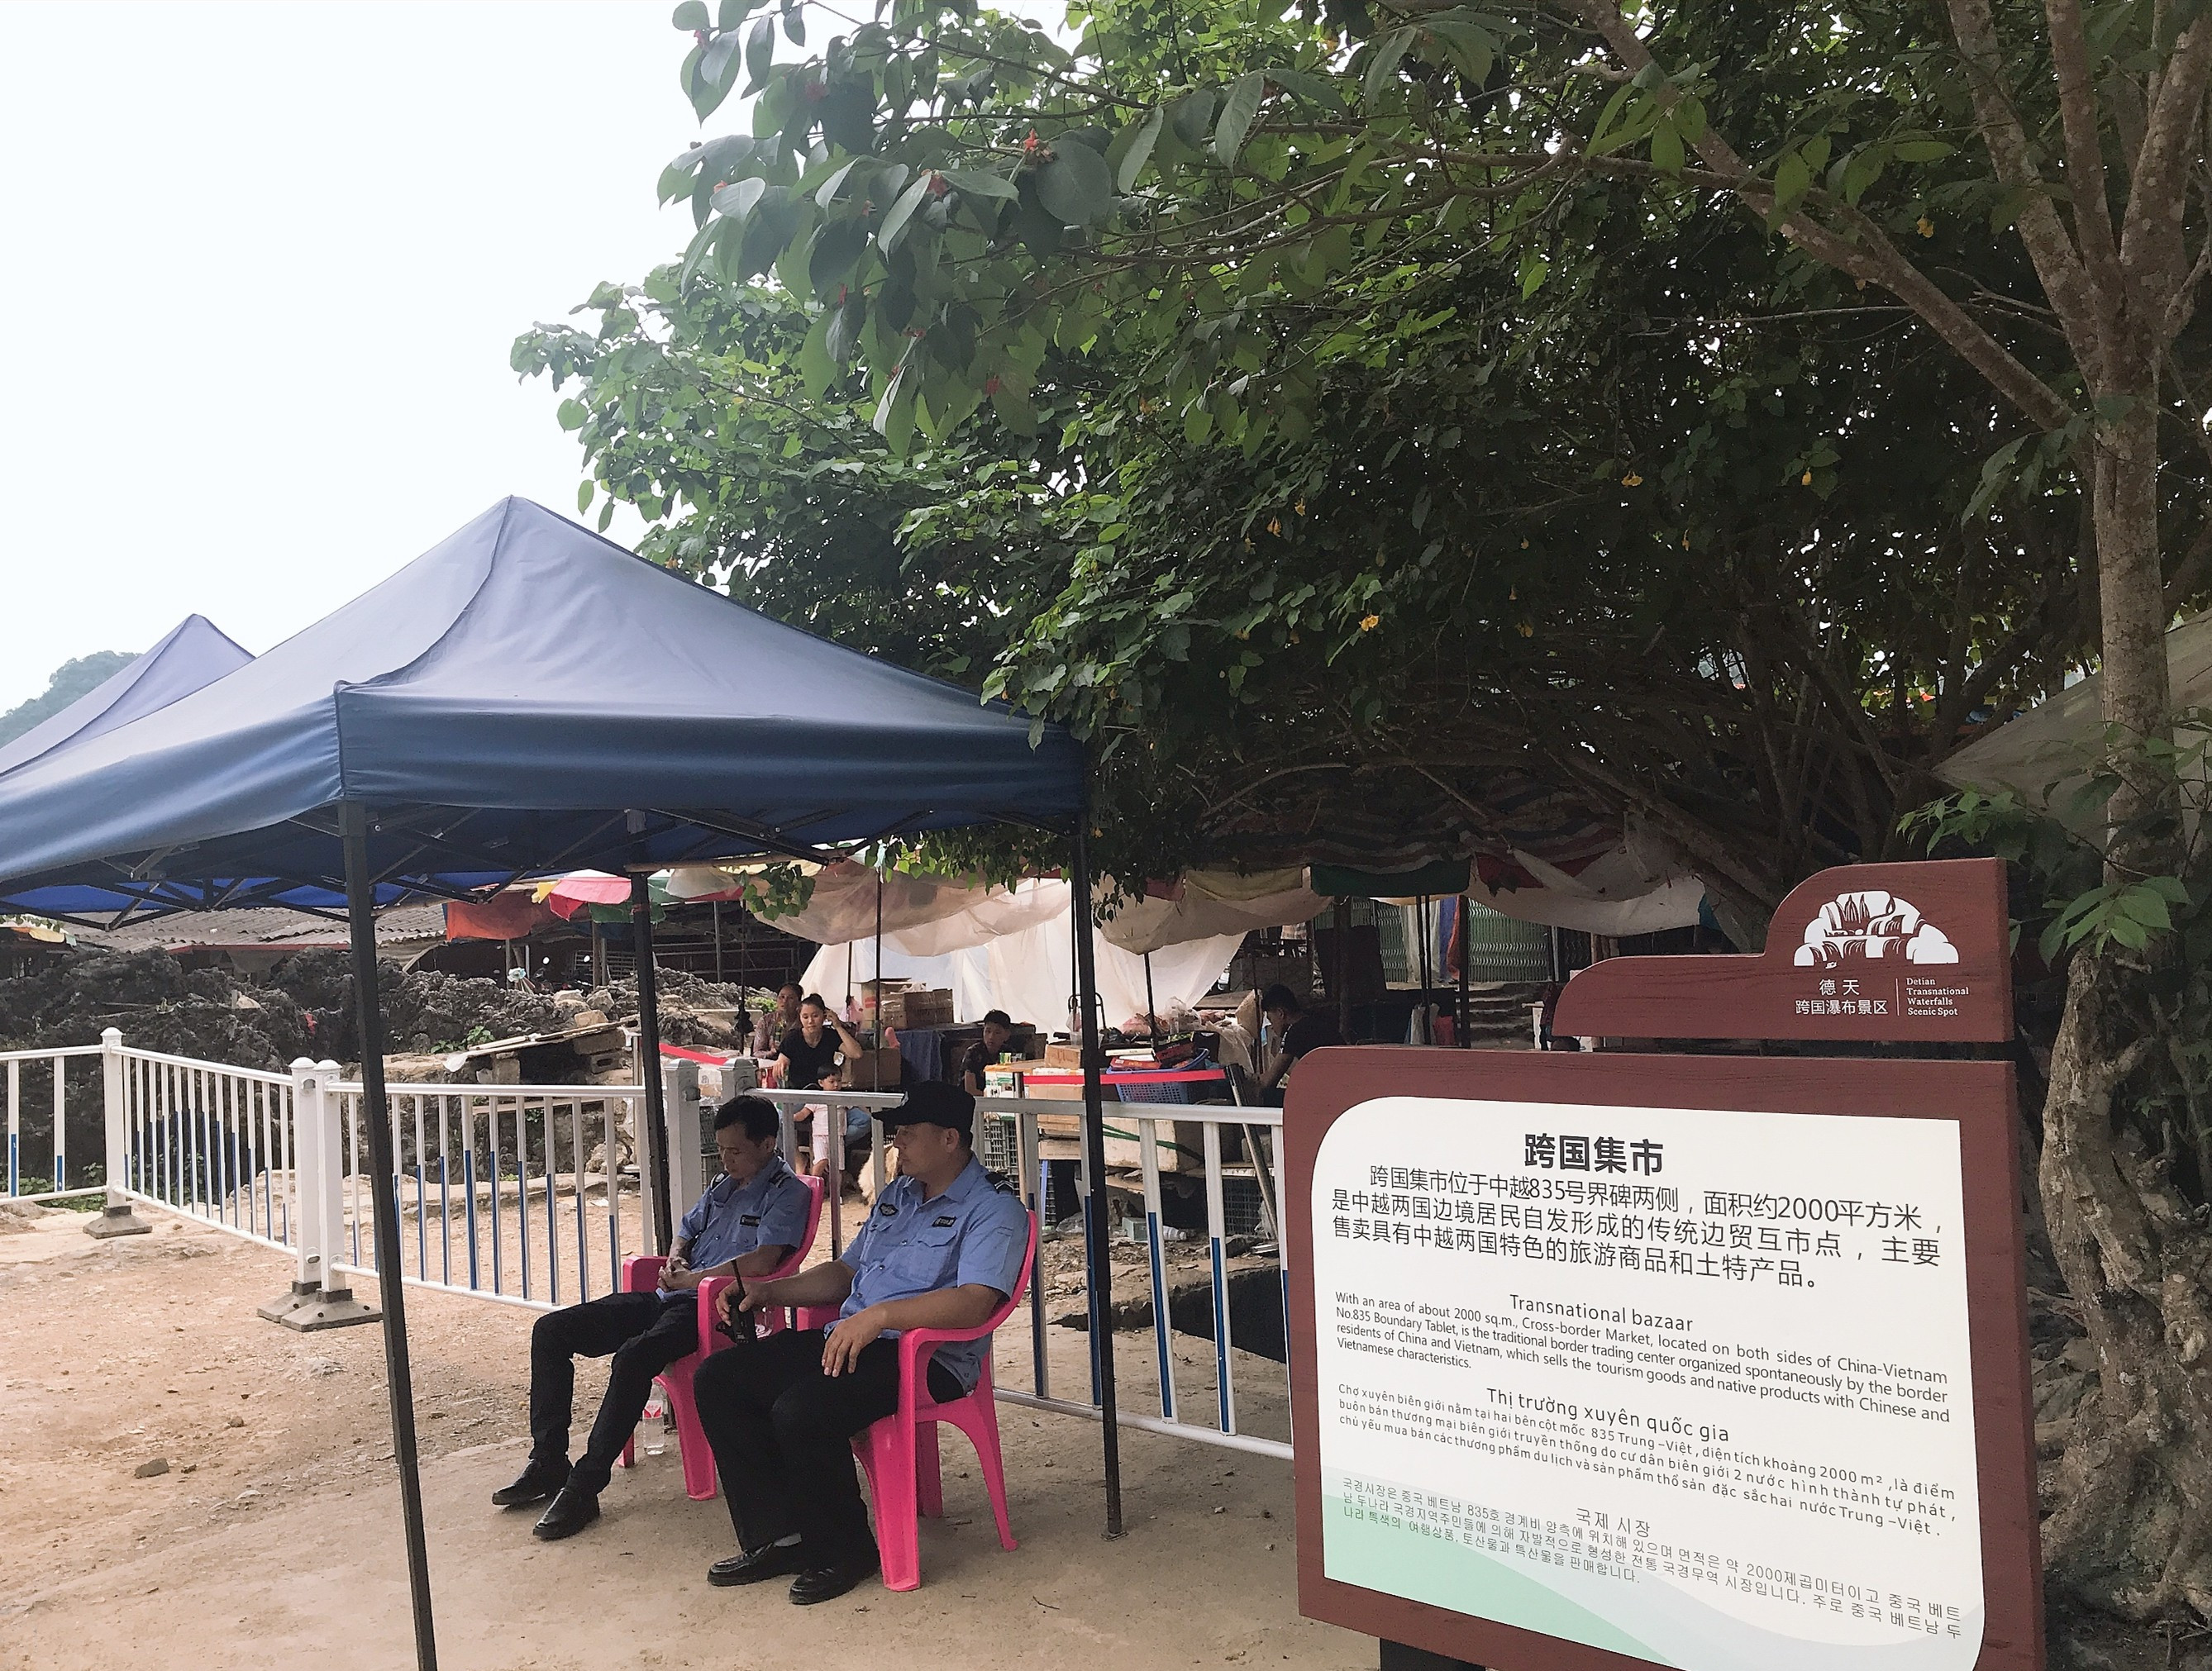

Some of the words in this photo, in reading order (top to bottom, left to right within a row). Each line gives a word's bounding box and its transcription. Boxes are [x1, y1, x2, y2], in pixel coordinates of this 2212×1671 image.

[1906, 978, 1936, 986] Detian
[1906, 987, 1969, 995] Transnational
[1795, 999, 1889, 1016] 跨国瀑布景区
[1907, 997, 1953, 1006] Waterfalls
[1907, 1007, 1936, 1016] Scenic
[1938, 1007, 1958, 1016] Spot
[1524, 1133, 1664, 1177] 跨国集市
[1509, 1294, 1625, 1323] Transnational
[1633, 1308, 1693, 1331] bazaar
[1336, 1292, 1359, 1305] With
[1363, 1298, 1375, 1307] an
[1379, 1300, 1400, 1311] area
[1404, 1302, 1415, 1312] of
[1418, 1303, 1451, 1317] about
[1455, 1308, 1481, 1321] 2000
[1523, 1317, 1601, 1338] Cross-border
[1606, 1328, 1652, 1347] Market,
[1659, 1334, 1706, 1352] located
[1713, 1345, 1729, 1355] on
[1737, 1344, 1769, 1360] both
[1777, 1350, 1812, 1366] sides
[1817, 1355, 1831, 1368] of
[1838, 1358, 1947, 1383] China-Vietnam
[1337, 1337, 1394, 1356] Vietnamese
[1397, 1346, 1471, 1369] characteristics.
[1337, 1307, 1371, 1321] No.835
[1375, 1312, 1422, 1332] Boundary
[1425, 1320, 1458, 1336] Tablet,
[1461, 1324, 1469, 1336] is
[1472, 1326, 1490, 1339] the
[1492, 1330, 1547, 1347] traditional
[1551, 1337, 1589, 1353] border
[1591, 1344, 1633, 1363] trading
[1638, 1353, 1675, 1365] center
[1679, 1358, 1741, 1374] organized
[1746, 1367, 1843, 1392] spontaneously
[1847, 1376, 1864, 1394] by
[1868, 1380, 1892, 1395] the
[1897, 1383, 1947, 1402] border
[1337, 1324, 1381, 1338] residents
[1385, 1330, 1394, 1340] of
[1398, 1331, 1427, 1345] China
[1431, 1338, 1451, 1349] and
[1454, 1340, 1502, 1359] Vietnam,
[1506, 1348, 1539, 1363] which
[1543, 1354, 1568, 1367] sells
[1572, 1357, 1591, 1370] the
[1596, 1362, 1643, 1378] tourism
[1647, 1371, 1686, 1384] goods
[1690, 1376, 1714, 1388] and
[1718, 1380, 1757, 1394] native
[1761, 1387, 1820, 1403] products
[1823, 1393, 1854, 1408] with
[1859, 1397, 1916, 1417] Chinese
[1922, 1409, 1949, 1422] and
